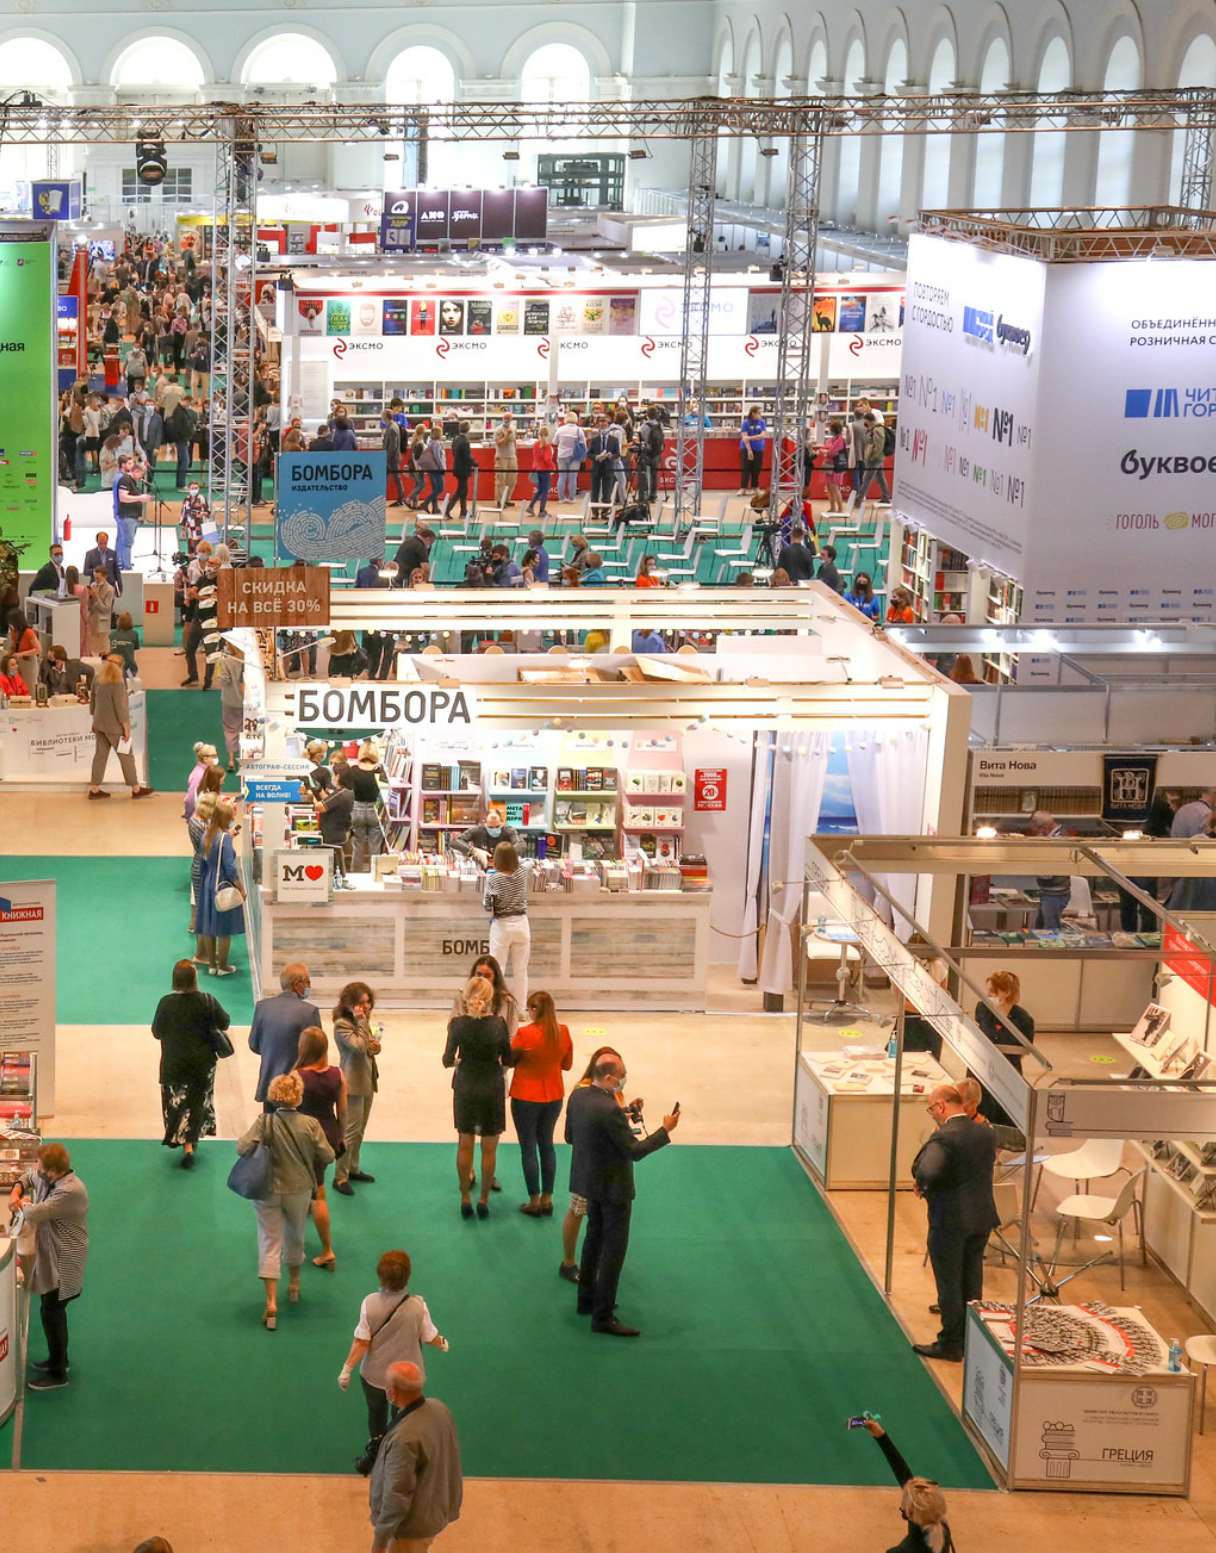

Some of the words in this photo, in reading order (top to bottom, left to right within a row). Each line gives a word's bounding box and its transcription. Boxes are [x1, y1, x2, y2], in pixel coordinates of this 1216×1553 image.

[348, 342, 384, 350] ЭКСМО
[452, 342, 487, 350] ЭКСМО
[560, 341, 589, 350] КСМО
[865, 338, 902, 348] ЭКСМО
[1130, 335, 1206, 347] РОЗНИЧНАЯ
[993, 407, 1014, 447] №1
[291, 464, 373, 481] БОМБОРА
[912, 429, 927, 467] №1
[1007, 475, 1025, 508] №1
[291, 484, 348, 492] ИЗДАТЕЛЬСТВО
[1116, 514, 1160, 531] ГОГОЛЬ
[242, 581, 307, 596] СКИДКА
[227, 602, 250, 615] НА
[253, 597, 282, 613] ВСЁ
[287, 599, 321, 613] 30%
[297, 689, 472, 726] БОМБОРА
[30, 734, 84, 747] БИБЛИОТЕКИ
[979, 760, 1006, 770] Вита
[1008, 760, 1037, 770] Нова
[1, 909, 42, 920] КНИЖНАЯ
[441, 939, 490, 955] БОМБ
[1101, 1447, 1154, 1463] ГРЕЦИЯ
